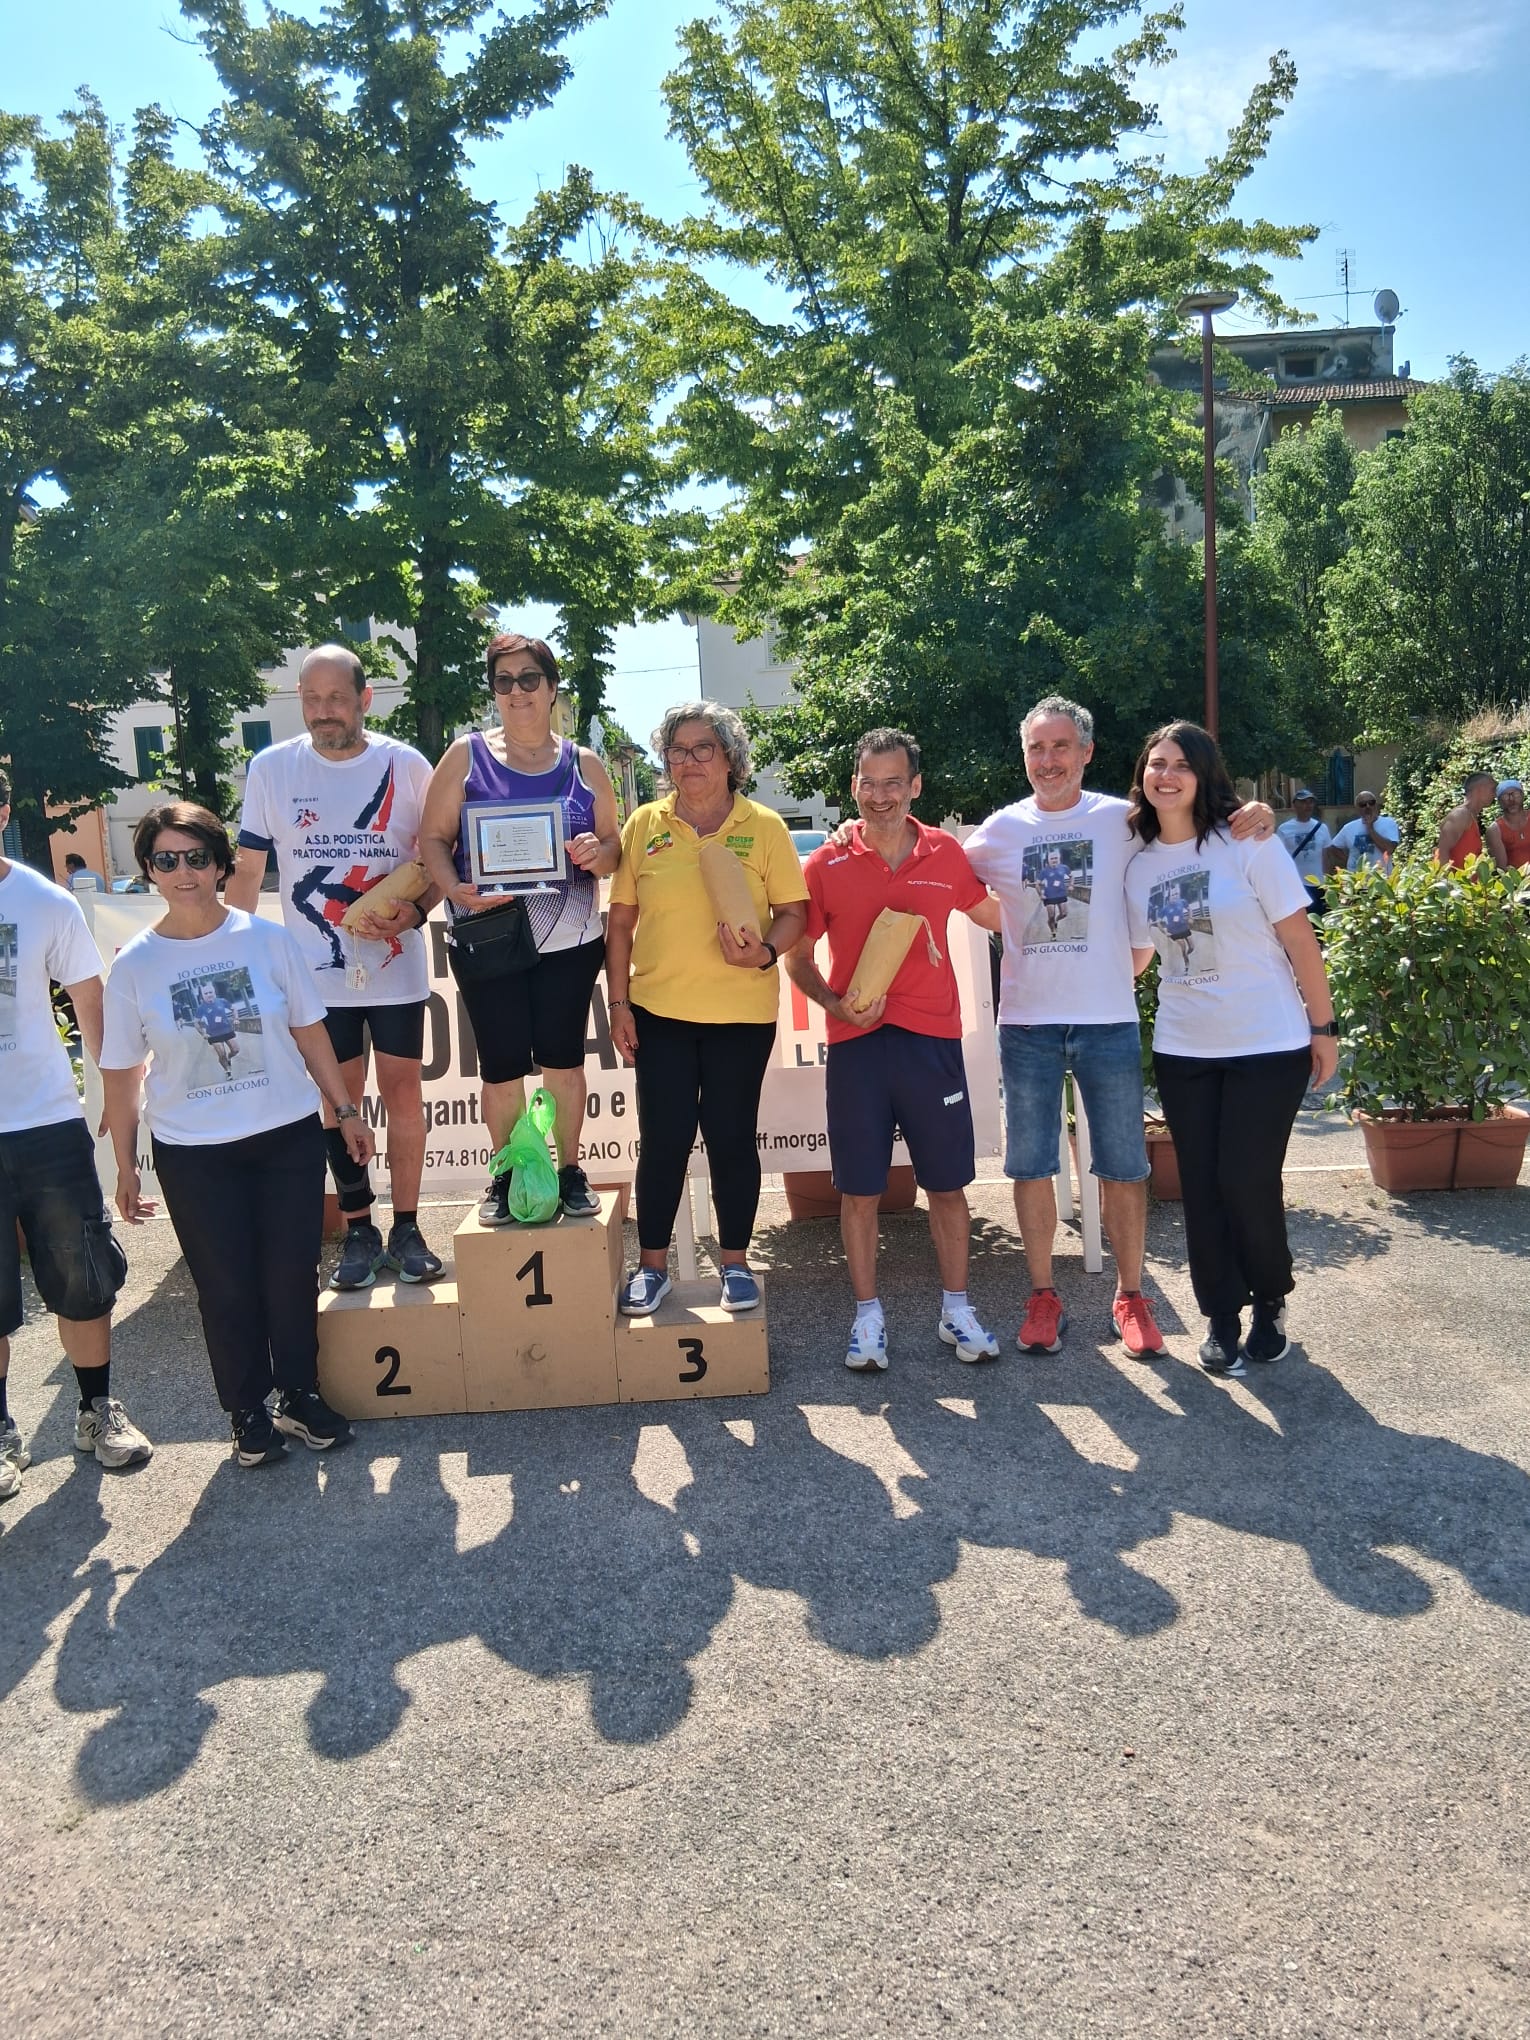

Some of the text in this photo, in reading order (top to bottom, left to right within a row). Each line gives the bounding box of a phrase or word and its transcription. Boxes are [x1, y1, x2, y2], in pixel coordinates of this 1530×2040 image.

[305, 834, 386, 845] A.S.D. PODISTICA
[1045, 832, 1083, 841] CORRO
[293, 848, 350, 859] PRATONORD
[359, 847, 399, 858] NARNALI
[1167, 863, 1201, 879] CORRO
[1039, 944, 1088, 954] GIACOMO
[177, 960, 235, 980] IO CORRO
[186, 1077, 270, 1100] CON GIACOMO
[515, 1250, 553, 1307] 1
[678, 1338, 708, 1383] 3
[374, 1346, 412, 1396] 2
